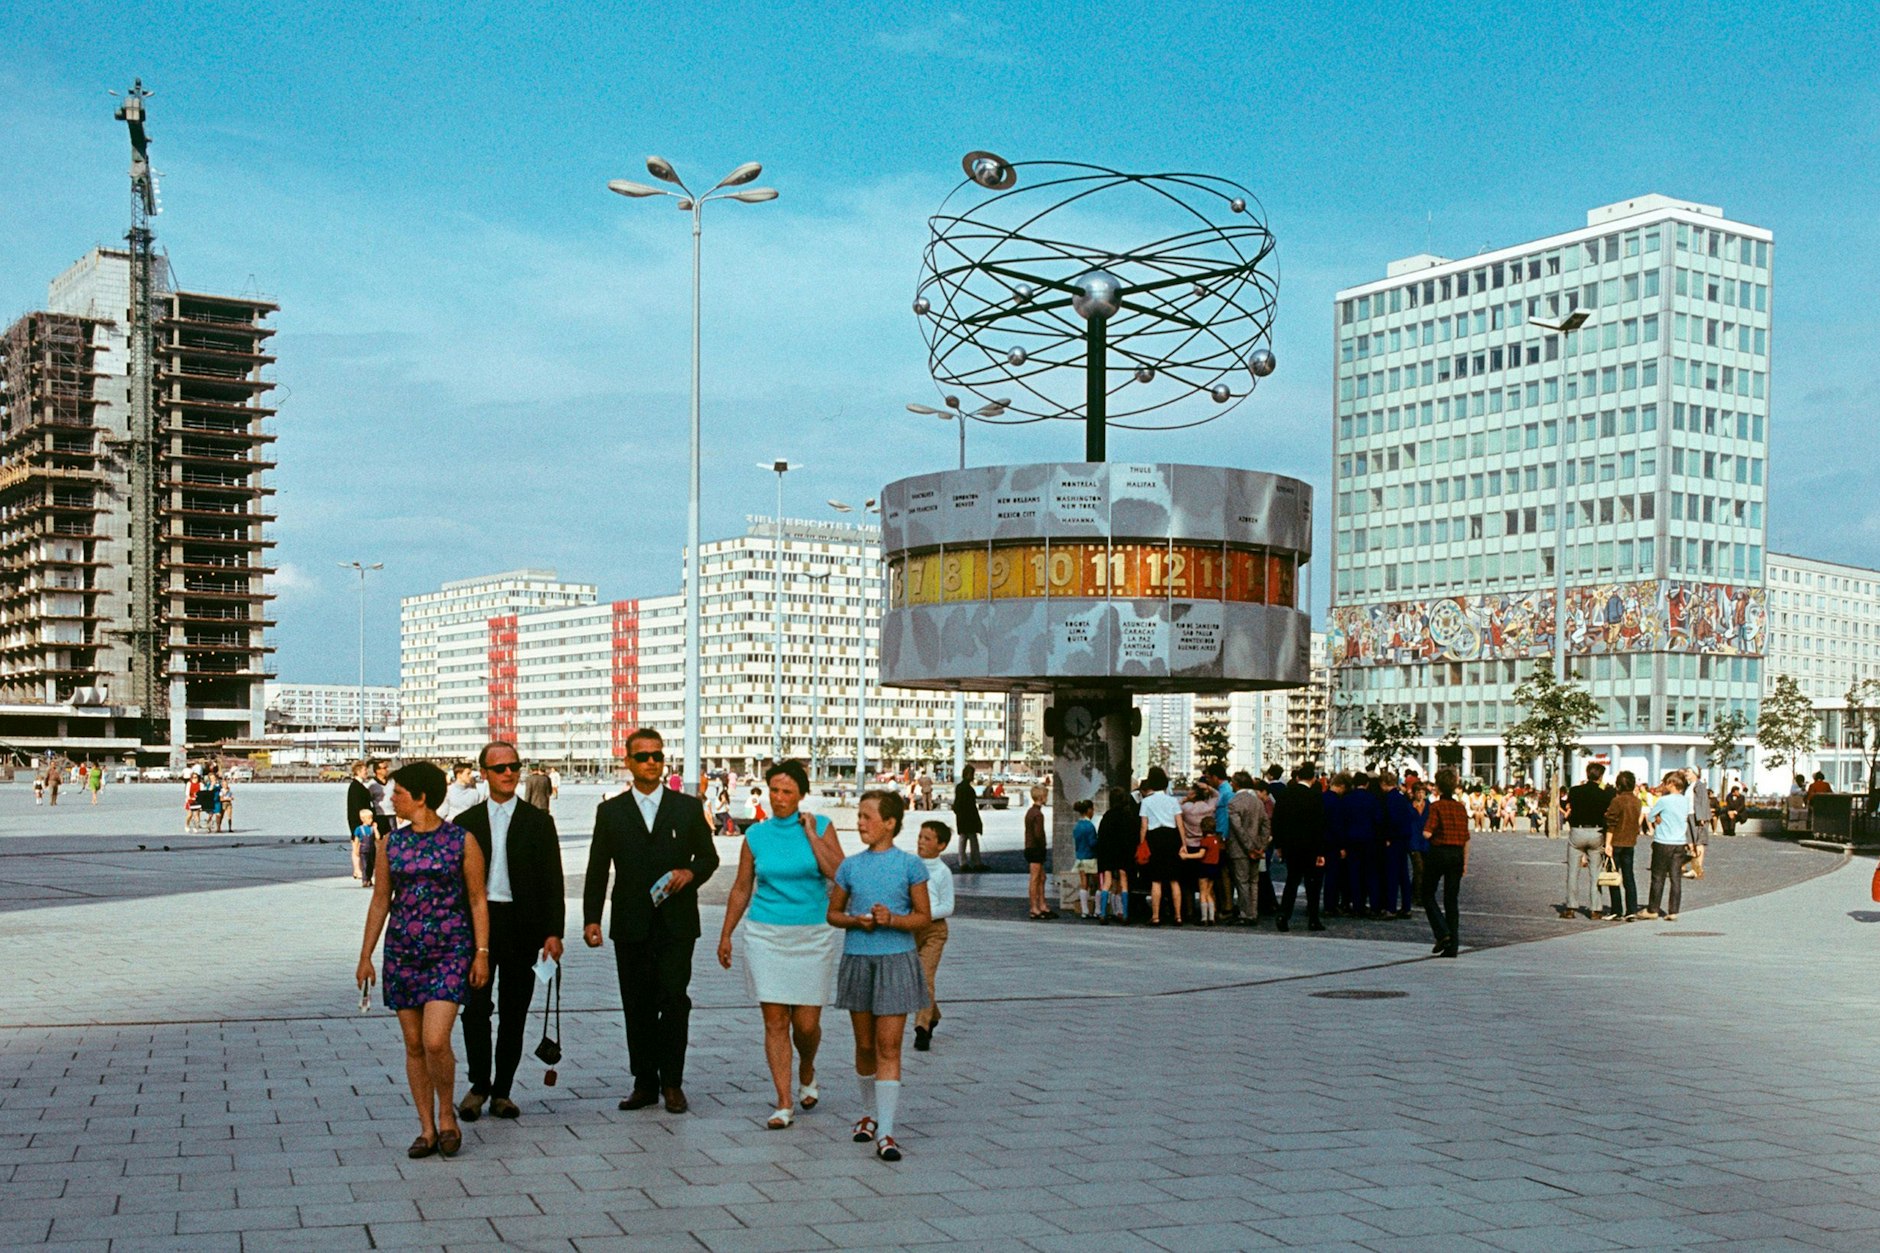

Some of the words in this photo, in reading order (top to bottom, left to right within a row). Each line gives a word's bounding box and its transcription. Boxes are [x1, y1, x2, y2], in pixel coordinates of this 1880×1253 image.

[911, 561, 926, 596] 7
[942, 557, 962, 592] 8
[987, 556, 1011, 590] 9
[1030, 553, 1074, 587] 10
[1091, 553, 1125, 586] 11
[1146, 553, 1186, 586] 12
